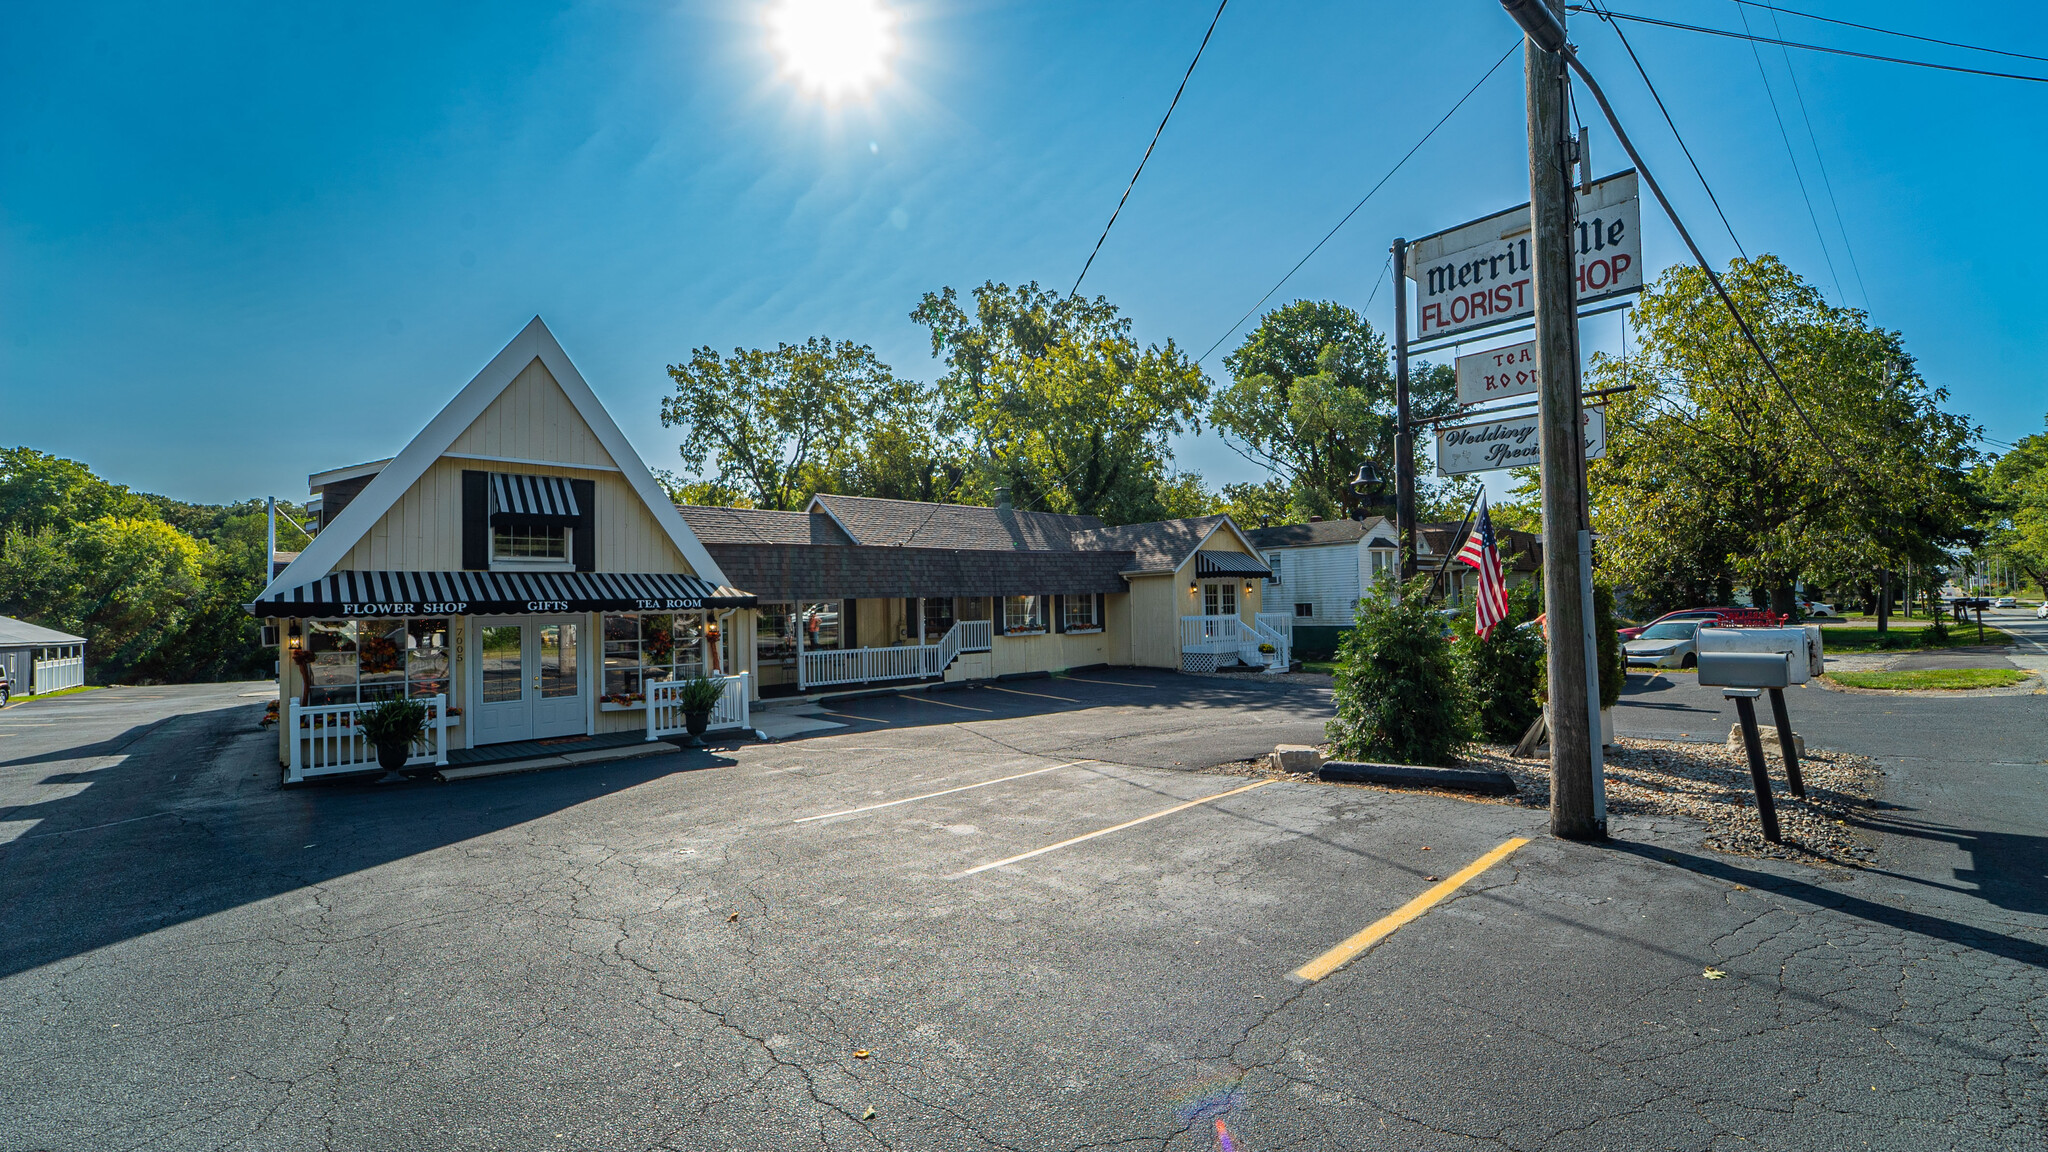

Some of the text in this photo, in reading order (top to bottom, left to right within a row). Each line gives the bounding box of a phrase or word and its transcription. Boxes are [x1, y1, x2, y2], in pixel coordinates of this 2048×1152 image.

[1422, 253, 1632, 332] FLORIST HOP
[1446, 424, 1536, 447] Wedding
[343, 602, 467, 615] FLOWER SHOP
[527, 601, 569, 611] GIFTS
[636, 599, 702, 609] TEA ROOM
